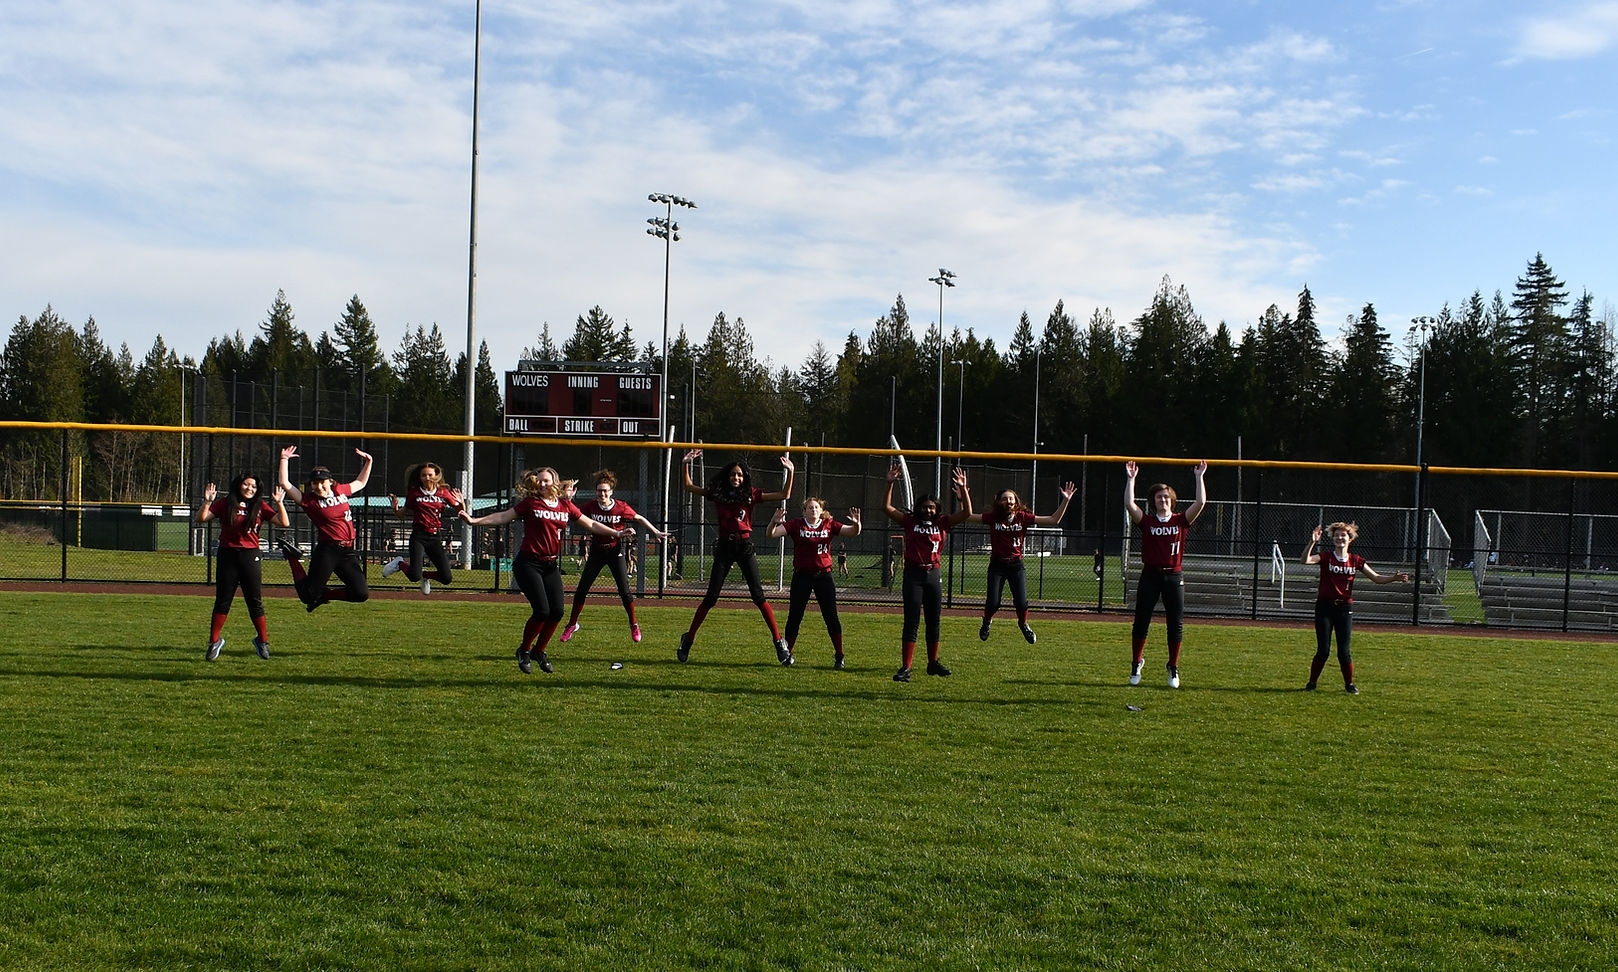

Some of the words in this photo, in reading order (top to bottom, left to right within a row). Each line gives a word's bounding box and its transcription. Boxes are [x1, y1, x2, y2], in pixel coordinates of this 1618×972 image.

[512, 374, 549, 387] WOLVES
[568, 376, 599, 389] INNING
[619, 377, 652, 390] GUESTS
[509, 419, 529, 431] BALL
[565, 420, 594, 432] STRIKE
[622, 421, 639, 433] OUT
[533, 509, 569, 522] WOLVES
[591, 513, 621, 523] WOLVES
[799, 529, 829, 538] WOLVES
[817, 543, 828, 554] 24
